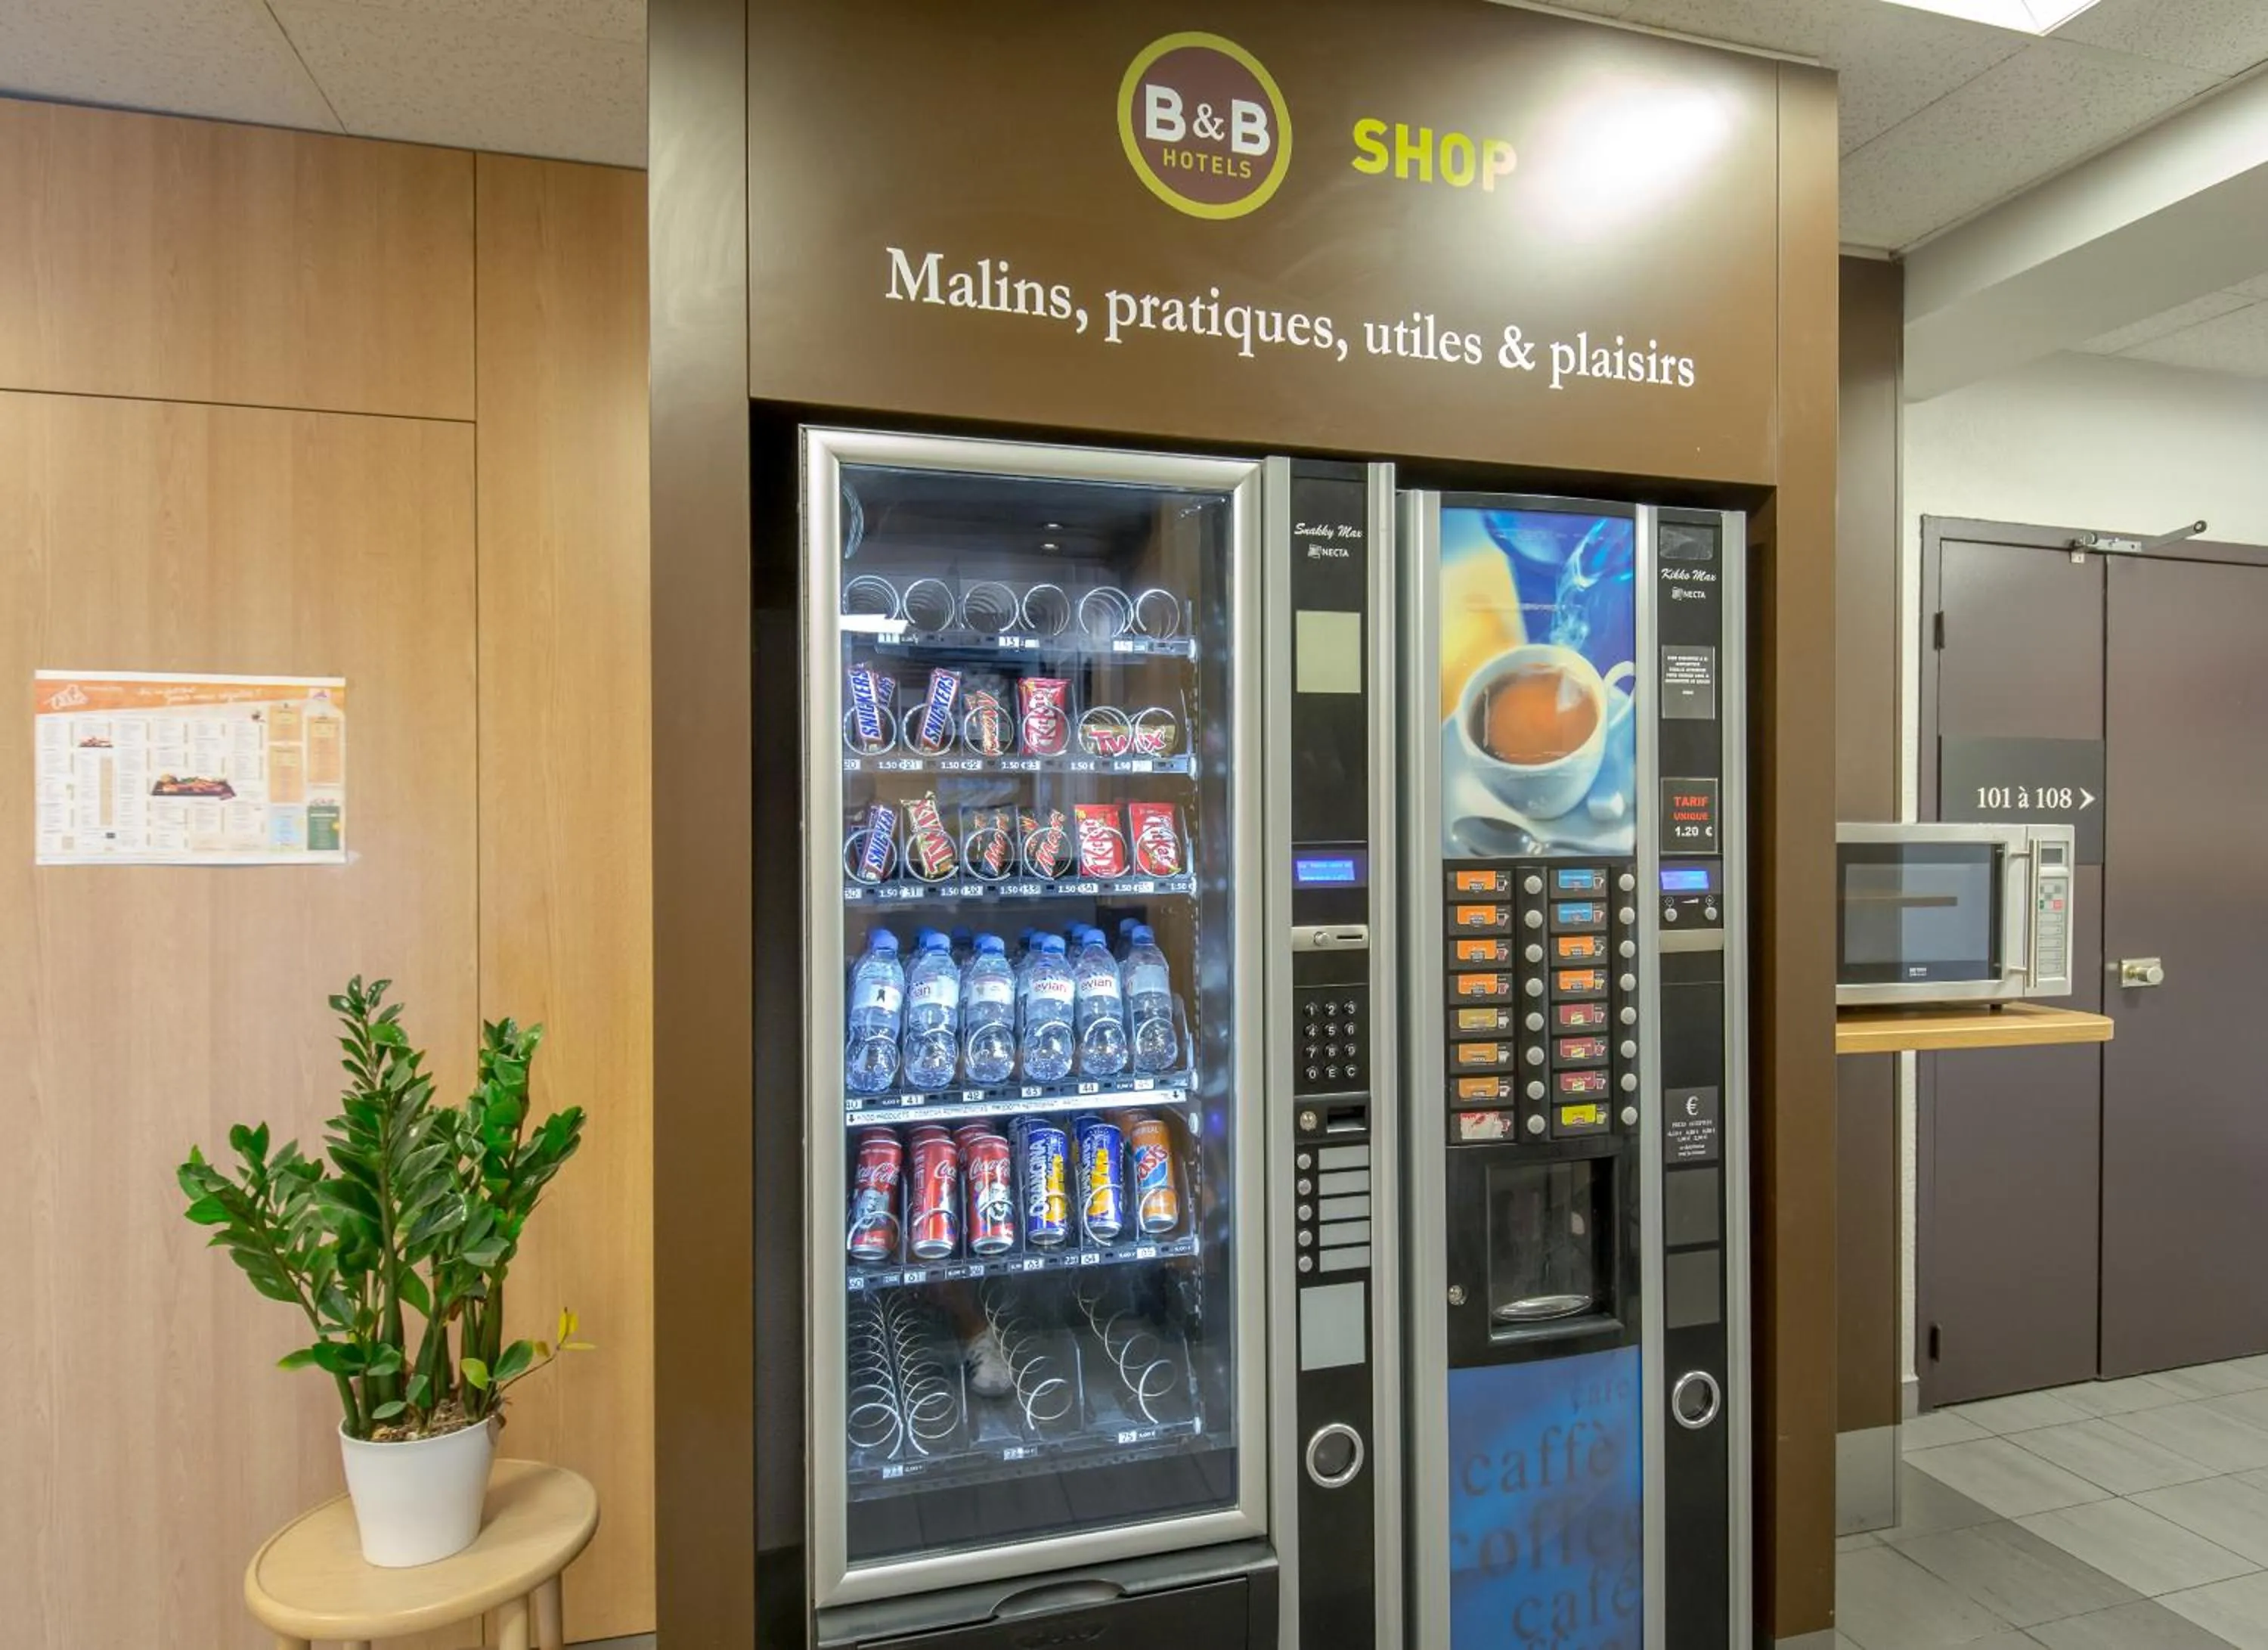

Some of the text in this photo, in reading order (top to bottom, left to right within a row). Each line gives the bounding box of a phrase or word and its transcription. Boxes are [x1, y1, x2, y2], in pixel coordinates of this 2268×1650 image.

[1145, 84, 1271, 157] B&B
[1163, 148, 1252, 180] HOTELS
[1352, 118, 1517, 193] SHOP
[885, 247, 1696, 389] Malins, pratiques, utiles & plaisirs
[1322, 548, 1349, 558] NECTA
[850, 668, 881, 738] SNICKERS
[925, 675, 955, 745] SNICKERS
[1673, 796, 1709, 808] TARIF
[1976, 786, 2072, 809] 101 à 108
[1673, 811, 1709, 820] UNIQUE
[1675, 826, 1699, 837] 1.20
[1033, 980, 1067, 994] evian
[1081, 979, 1112, 991] evian
[1685, 1095, 1699, 1115] €
[1461, 1420, 1615, 1497] caffè
